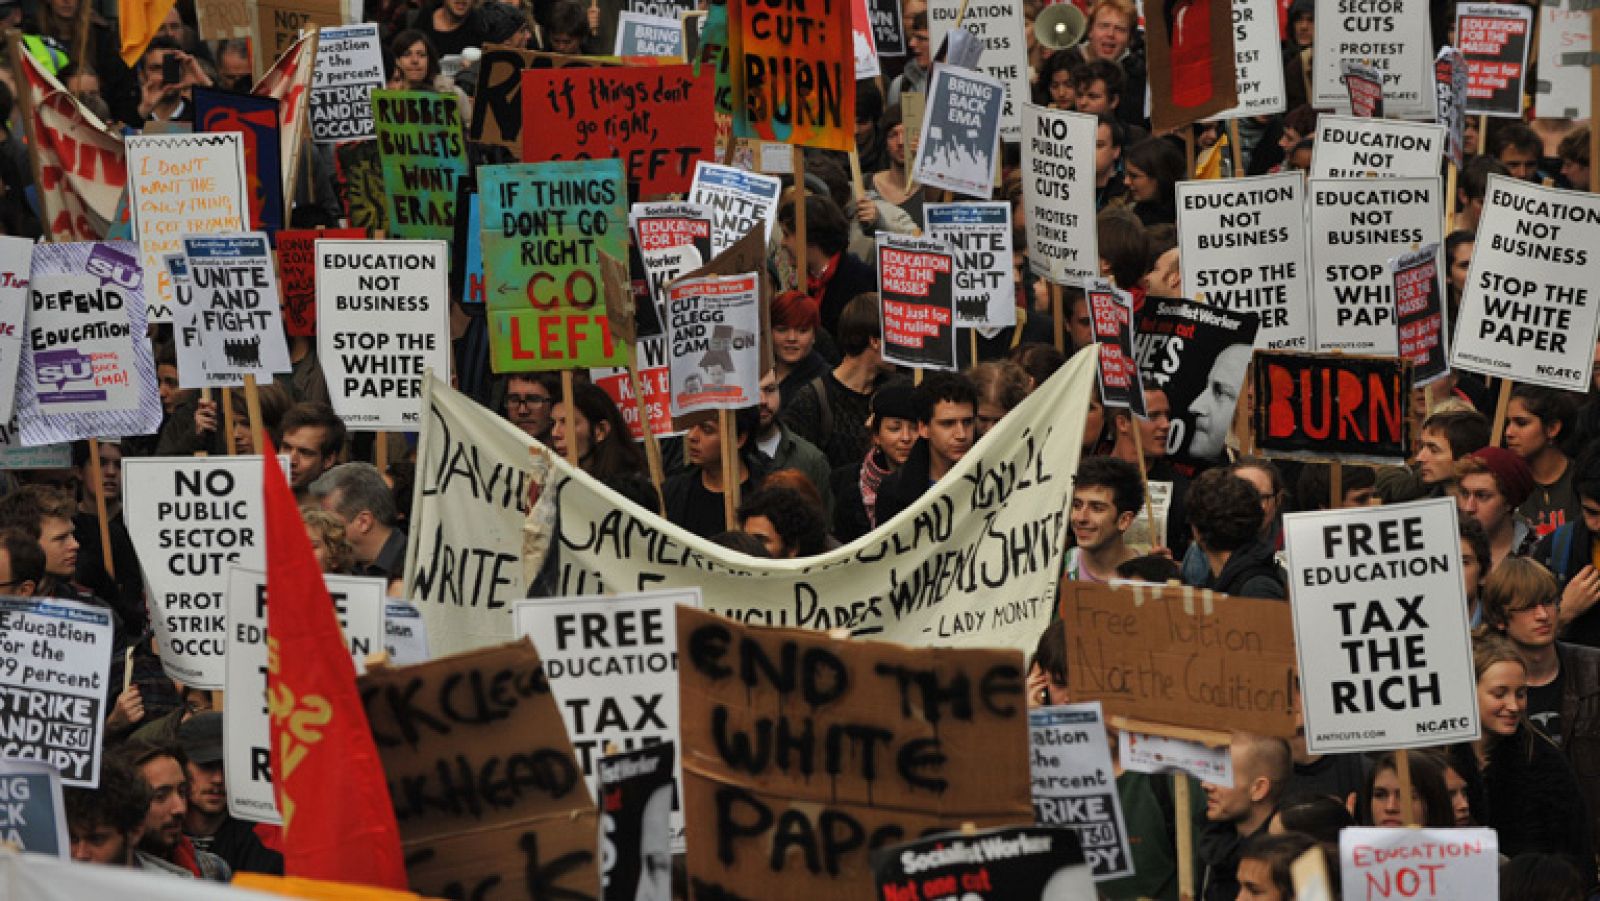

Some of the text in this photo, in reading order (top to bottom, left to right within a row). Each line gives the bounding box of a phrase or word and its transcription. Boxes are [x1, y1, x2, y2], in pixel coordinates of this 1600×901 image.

[1338, 0, 1403, 13] SECTOR
[635, 25, 679, 42] BRING
[752, 12, 826, 45] CUT:
[1344, 16, 1395, 32] CUTS
[1462, 19, 1524, 33] EDUCATION
[1462, 31, 1507, 43] FOR THE
[329, 54, 352, 66] the
[1340, 43, 1405, 55] PROTEST
[327, 67, 380, 85] percent
[548, 76, 692, 119] if things don't
[745, 54, 843, 128] BURN
[947, 77, 992, 99] BRING
[315, 104, 349, 118] AND
[378, 97, 458, 124] RUBBER
[948, 94, 986, 113] BACK
[316, 122, 374, 136] OCCUP
[577, 110, 659, 145] go right,
[947, 110, 982, 128] EMA
[1037, 115, 1067, 139] NO
[382, 132, 461, 157] BULLETS
[1031, 138, 1073, 161] PUBLIC
[1323, 128, 1431, 152] EDUCATION
[1032, 157, 1076, 182] SECTOR
[1354, 152, 1394, 169] NOT
[500, 178, 616, 208] IF THINGS
[1035, 179, 1070, 201] CUTS
[1184, 186, 1294, 210] EDUCATION
[1316, 189, 1429, 206] EDUCATION
[393, 195, 456, 226] ERAS
[1035, 206, 1078, 228] PROTEST
[1351, 210, 1392, 226] NOT
[1491, 189, 1600, 225] EDUCATION
[503, 209, 608, 238] DON'T GO
[641, 221, 707, 237] EDUCATION
[1220, 211, 1261, 228] NOT
[1516, 219, 1560, 241] NOT
[642, 235, 666, 246] FOR
[1036, 224, 1068, 243] STRIKE
[1198, 227, 1289, 250] BUSINESS
[1328, 228, 1423, 245] BUSINESS
[882, 250, 949, 271] EDUCATION
[1037, 242, 1078, 261] OCCUPY
[1491, 235, 1588, 266] BUSINESS
[324, 254, 436, 270] EDUCATION
[882, 263, 934, 282] FOR THE
[1326, 264, 1383, 282] STOP
[193, 267, 269, 288] UNITE
[359, 275, 400, 291] NOT
[955, 271, 1005, 288] GHT
[1197, 262, 1296, 287] STOP THE
[526, 270, 598, 311] GO
[882, 277, 928, 295] MASSES
[1205, 285, 1287, 309] WHITE
[1334, 286, 1391, 304] WHI
[1479, 271, 1588, 307] STOP THE
[31, 289, 123, 313] DEFEND
[210, 290, 259, 310] AND
[337, 296, 429, 311] BUSINESS
[671, 296, 700, 313] CUT
[203, 311, 272, 331] FIGHT
[672, 310, 724, 328] CLEGG
[885, 301, 948, 323] Not just for
[1337, 308, 1397, 326] PAP
[1484, 295, 1572, 330] WHITE
[31, 322, 129, 351] EDUCATION
[510, 314, 615, 360] LEFT
[673, 325, 706, 343] AND
[904, 321, 938, 335] ruling
[1479, 320, 1567, 353] PAPER
[333, 333, 435, 351] STOP THE
[342, 355, 424, 374] WHITE
[344, 378, 422, 398] PAPER
[1268, 364, 1401, 443] BURN
[175, 469, 234, 496] NO
[158, 501, 247, 521] PUBLIC
[159, 529, 254, 548] SECTOR
[1323, 517, 1424, 558] FREE
[413, 520, 518, 610] WRITE
[1303, 555, 1449, 586] EDUCATION
[166, 593, 223, 609] PROT
[168, 616, 225, 632] STRIK
[939, 610, 985, 637] LADY
[1075, 588, 1262, 654] Free Tuition
[1333, 595, 1429, 635] TAX
[0, 612, 96, 644] Education
[555, 609, 664, 650] FREE
[32, 641, 64, 661] the
[172, 640, 224, 655] OCCU
[1341, 634, 1427, 673] THE
[548, 653, 678, 678] DUCATIO
[690, 625, 1021, 720] END THE
[23, 665, 100, 689] percent
[1137, 662, 1173, 699] the
[1184, 654, 1293, 714] Coalition!
[1331, 672, 1442, 715] RICH
[565, 694, 667, 733] TAX
[49, 725, 88, 748] N30
[1316, 730, 1386, 742] ANTICUTS.COM
[711, 705, 947, 792] WHITE
[1040, 799, 1110, 824] RIKE
[902, 834, 1051, 873] Socialist Worker
[1354, 840, 1481, 867] EDUCATION
[884, 869, 991, 901] Not one cut
[1366, 863, 1447, 900] NOT
